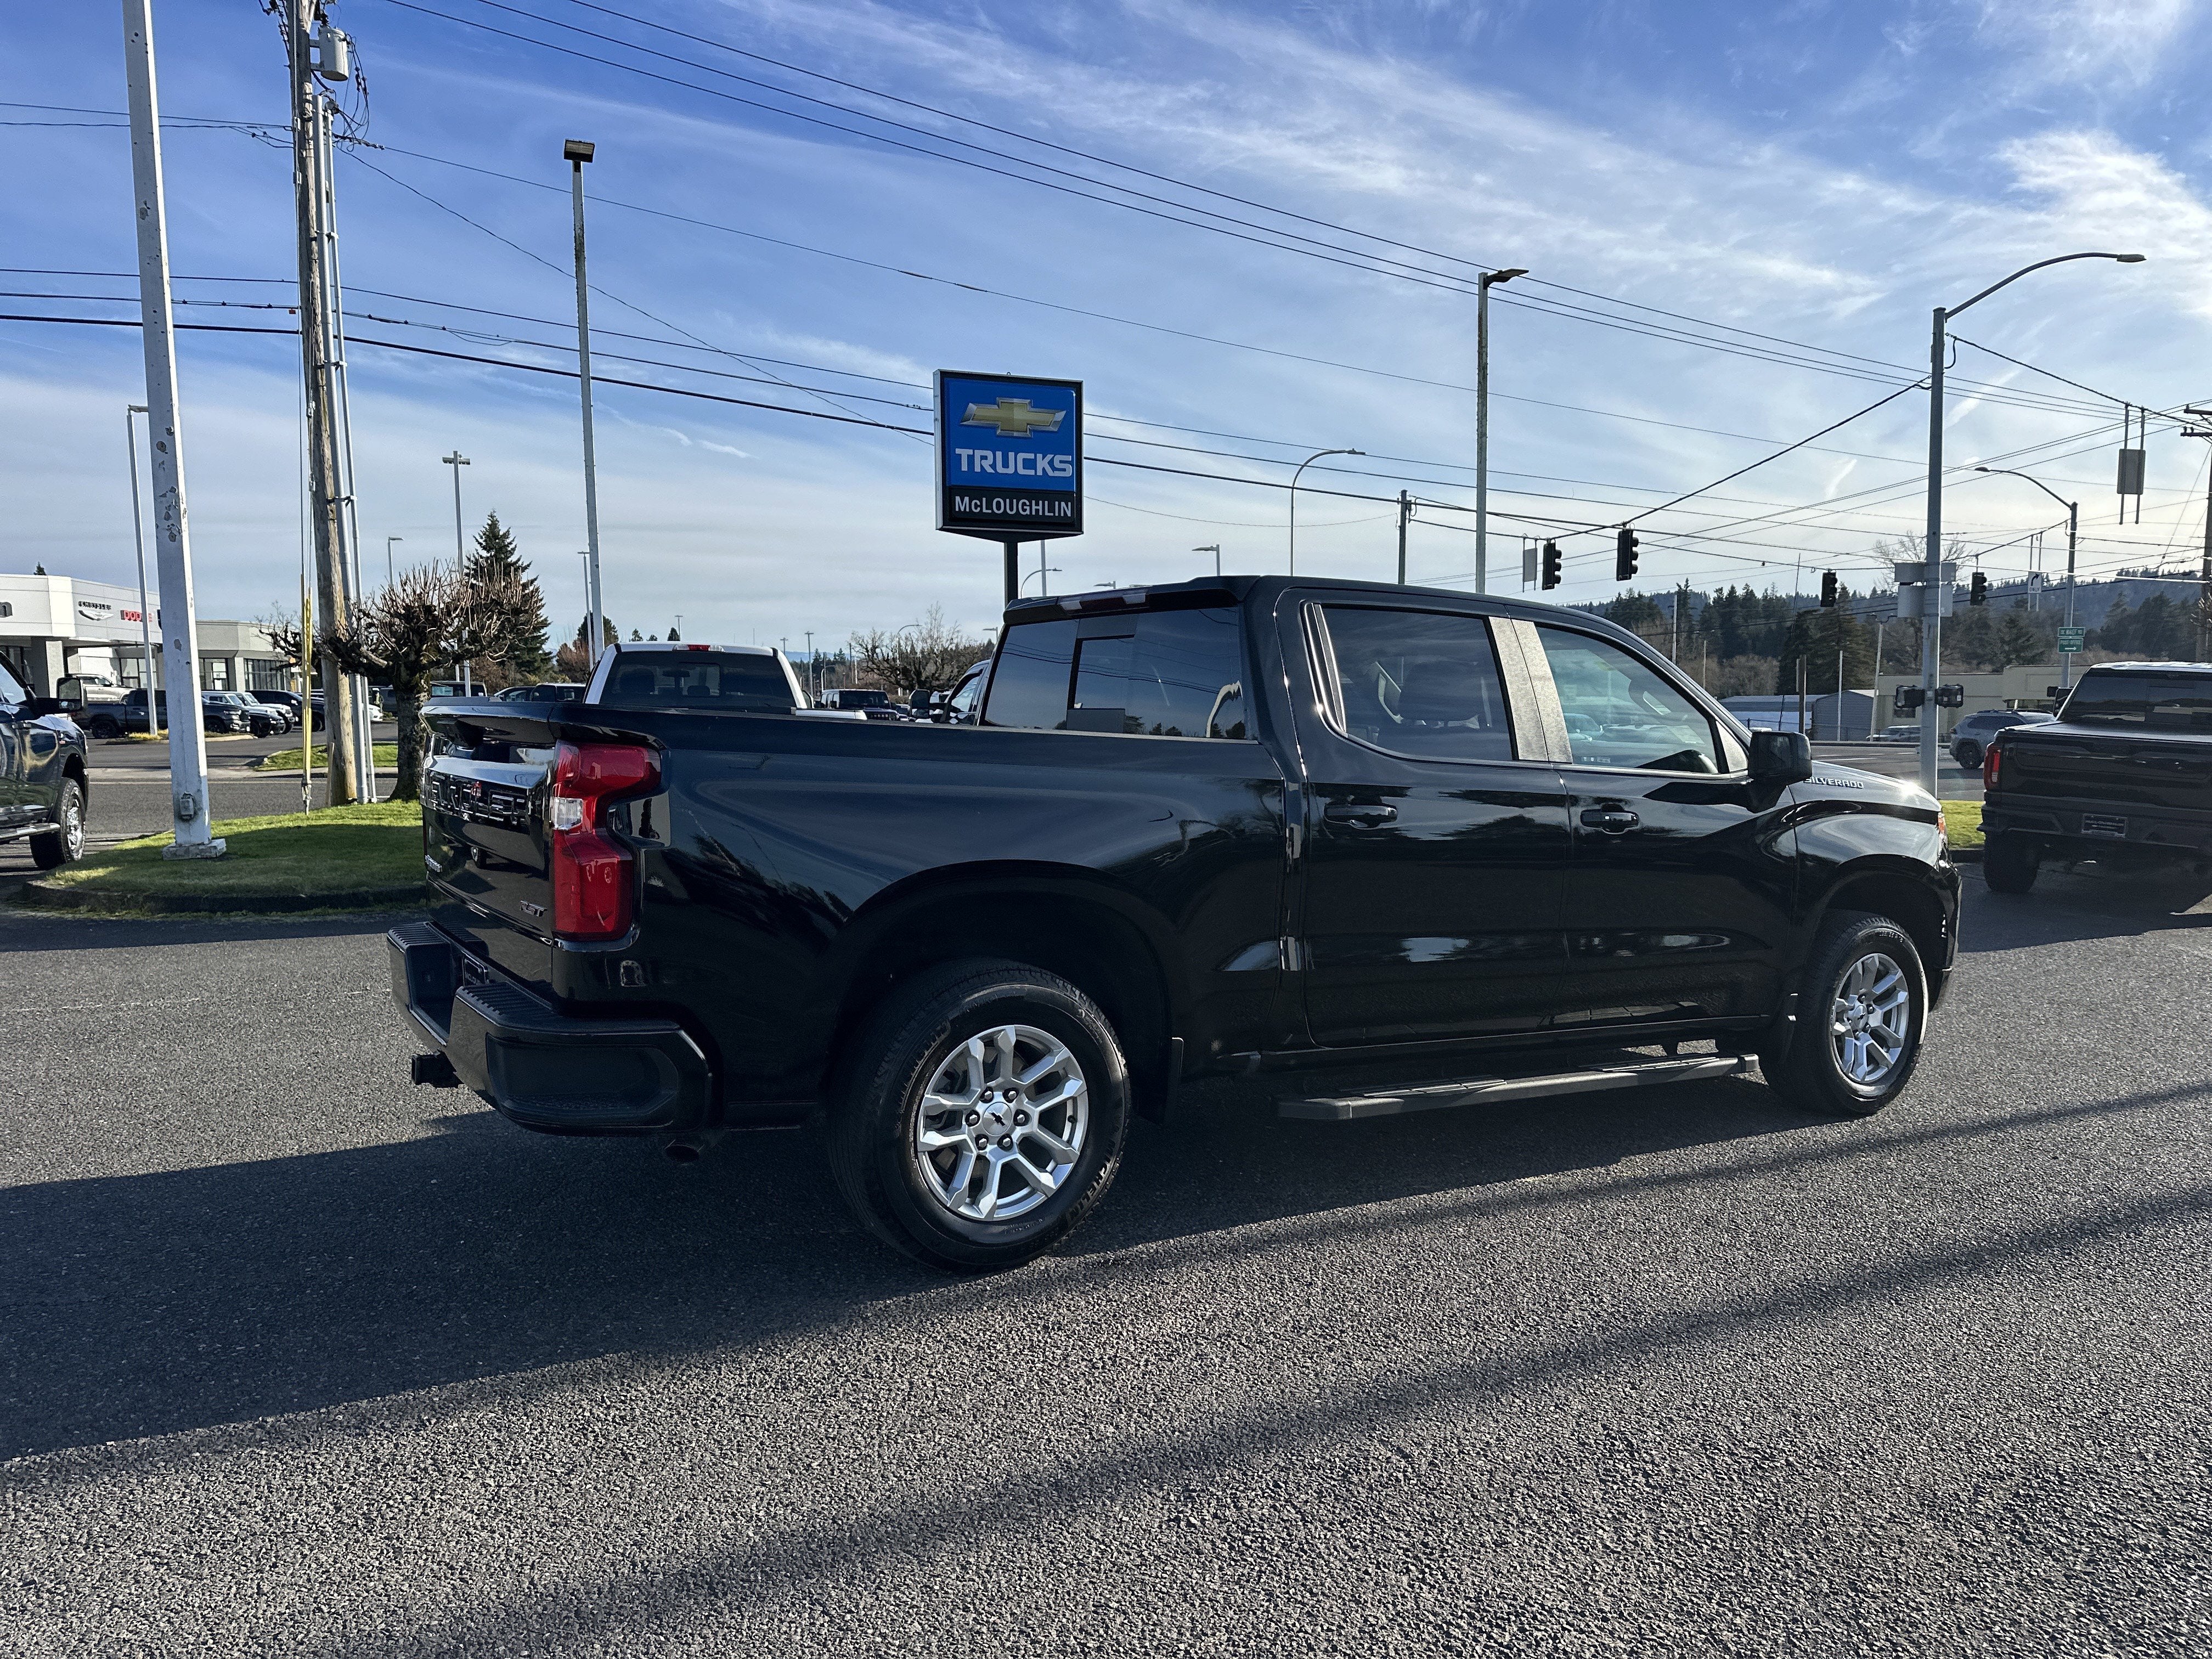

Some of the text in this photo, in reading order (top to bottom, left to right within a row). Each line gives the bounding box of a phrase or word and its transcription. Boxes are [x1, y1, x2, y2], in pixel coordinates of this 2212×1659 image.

[955, 448, 1073, 477] TRUCKS
[955, 495, 1072, 517] McLOUGHLIN
[1804, 776, 1864, 788] SILVERADO
[520, 900, 545, 917] RST
